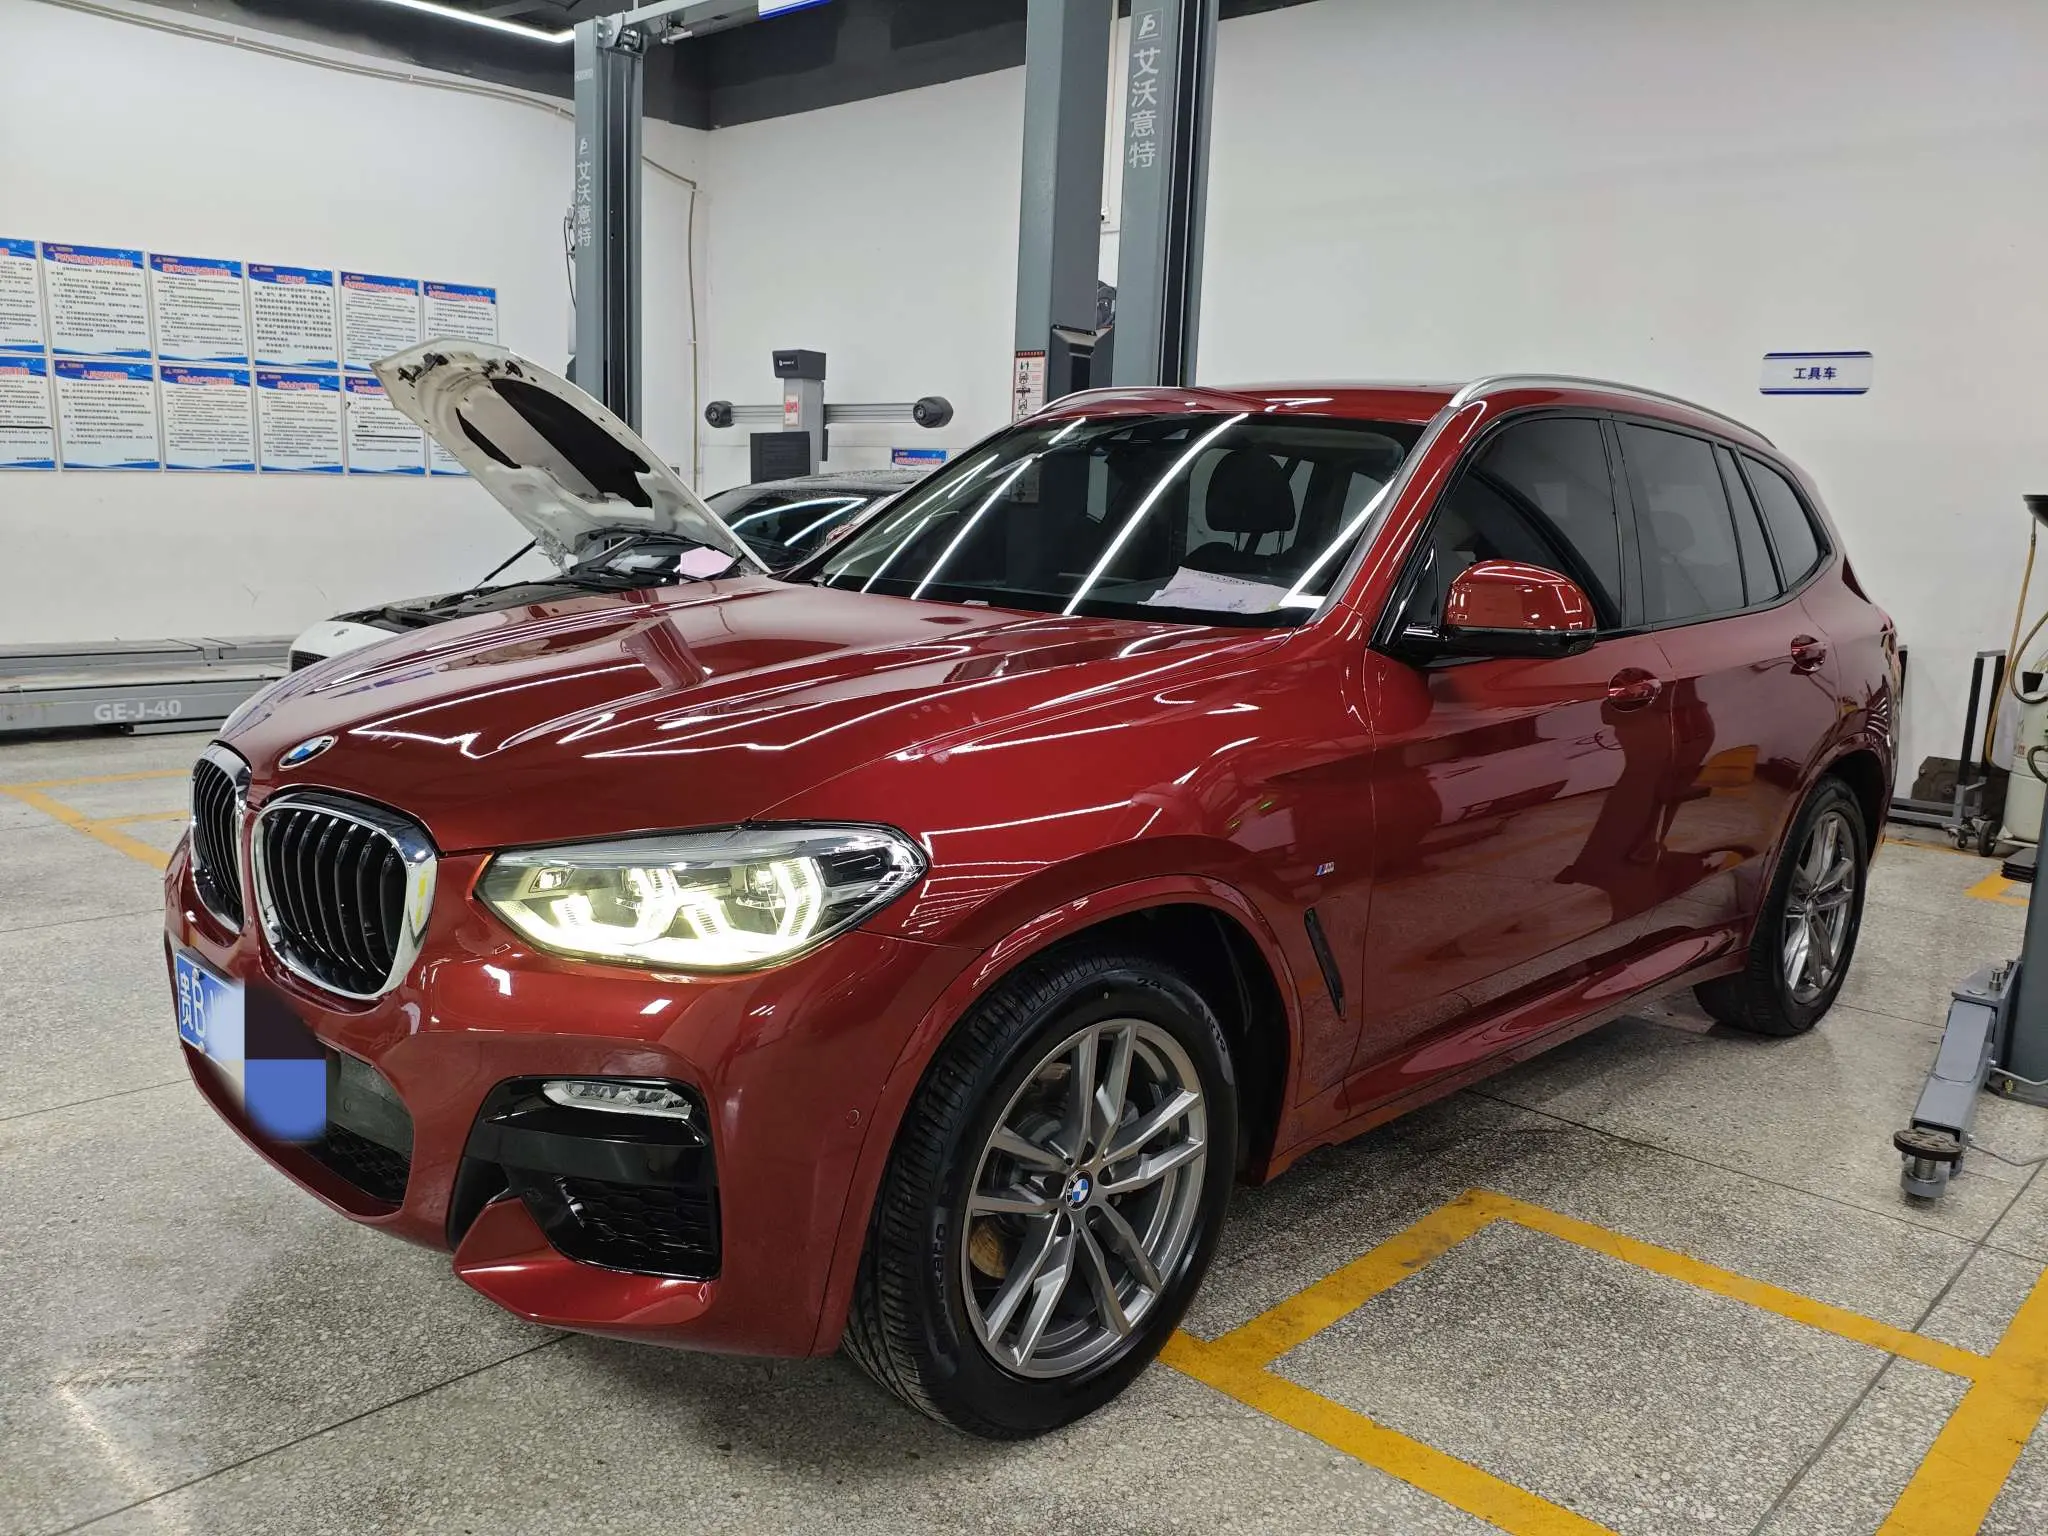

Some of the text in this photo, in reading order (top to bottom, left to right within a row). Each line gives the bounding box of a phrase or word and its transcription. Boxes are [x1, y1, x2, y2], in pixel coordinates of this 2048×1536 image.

[1129, 47, 1160, 169] 艾沃意特
[577, 161, 592, 247] 艾沃意特
[1793, 366, 1837, 380] 工具车
[94, 700, 182, 721] GE-J-40
